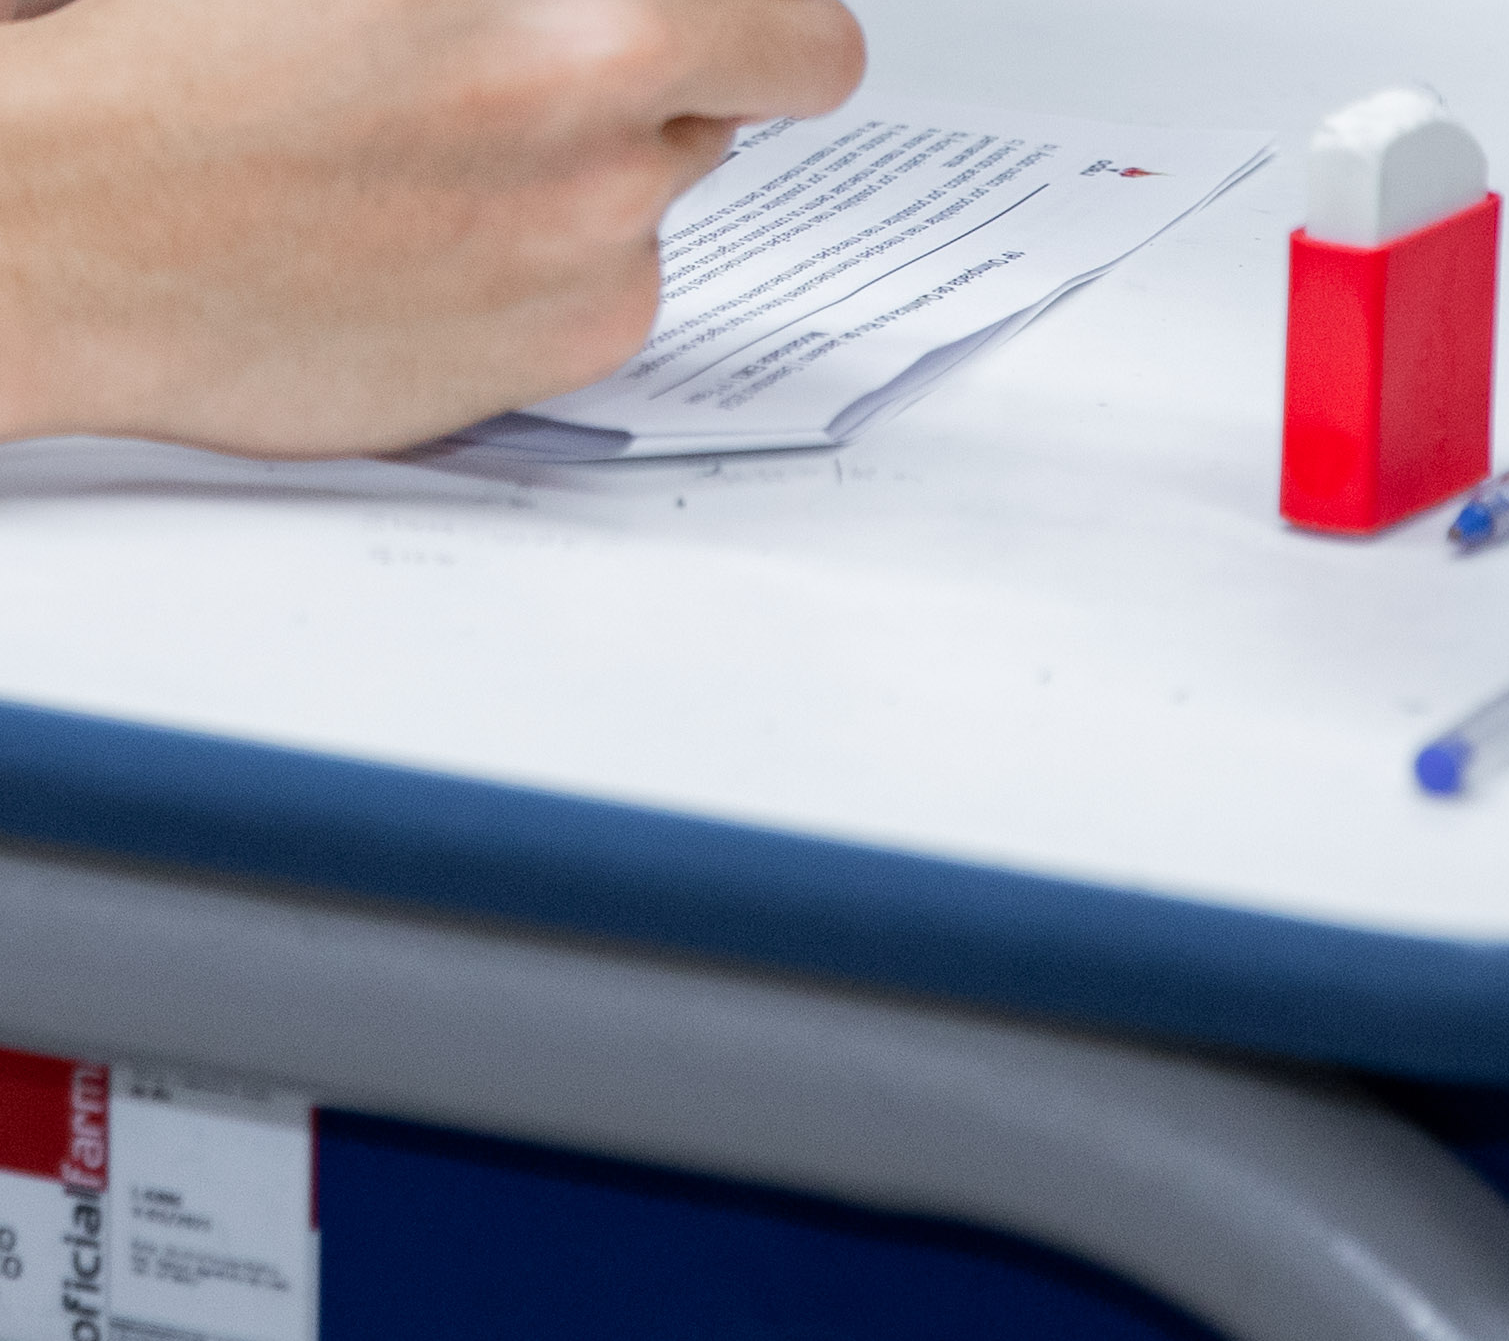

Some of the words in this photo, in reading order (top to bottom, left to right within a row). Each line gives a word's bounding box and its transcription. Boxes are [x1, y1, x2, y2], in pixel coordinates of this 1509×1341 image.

[759, 165, 807, 192] molecular
[828, 167, 877, 195] molecular
[728, 191, 765, 208] dentre
[759, 182, 811, 211] possibilitar
[798, 193, 835, 210] dentre
[830, 183, 882, 212] possibilitar
[880, 198, 931, 226] possibilitar
[923, 197, 974, 225] possibilitar
[687, 222, 740, 246] interações
[737, 216, 793, 242] compostos
[761, 222, 813, 247] interações
[811, 236, 863, 259] interações
[855, 235, 906, 258] interações
[688, 246, 766, 285] intermoleculares
[738, 258, 817, 299] intermoleculares
[783, 257, 861, 298] intermoleculares
[946, 258, 1009, 286] Olimpíada
[888, 293, 943, 315] Química
[61, 1059, 108, 1341] oficialfarm
